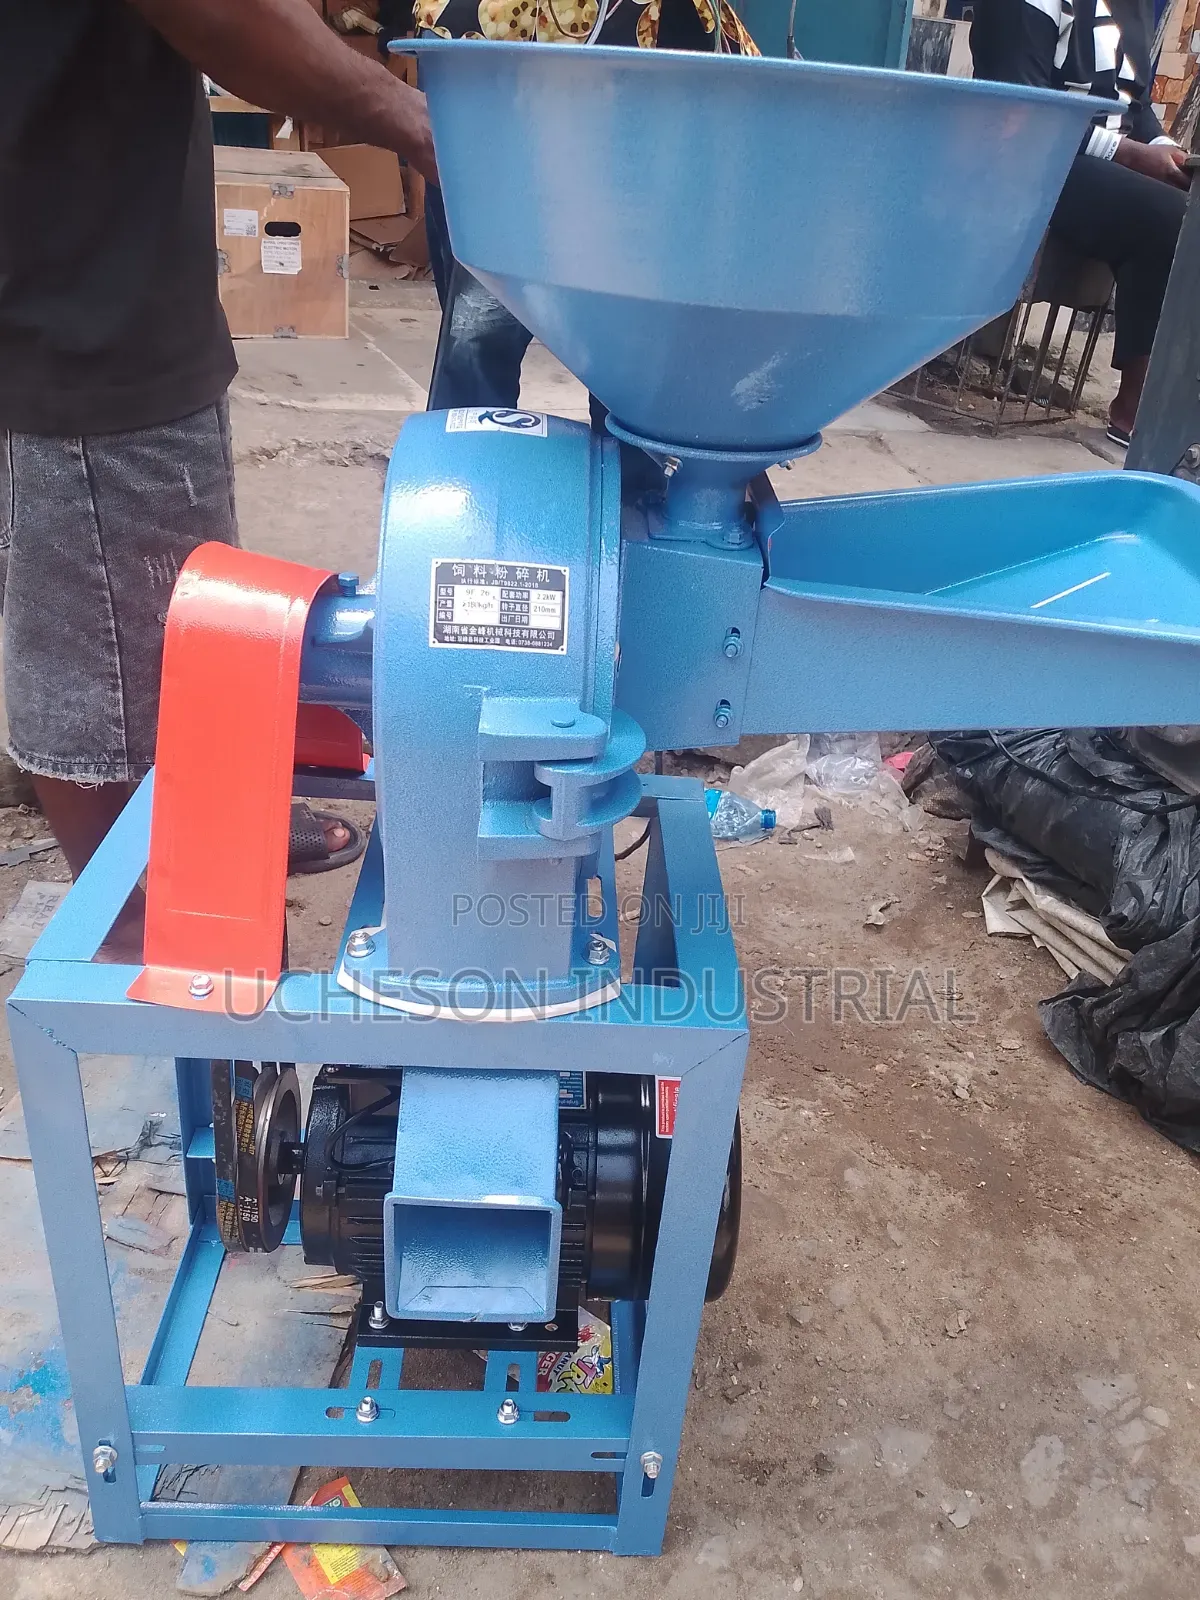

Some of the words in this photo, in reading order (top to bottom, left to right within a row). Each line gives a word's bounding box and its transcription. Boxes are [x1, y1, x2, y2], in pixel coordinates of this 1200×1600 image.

[452, 563, 550, 583] 饲料粉碎机
[501, 615, 529, 624] 出厂日期
[533, 605, 556, 614] 210mm
[242, 1196, 252, 1222] A-1150
[538, 1352, 559, 1376] GER
